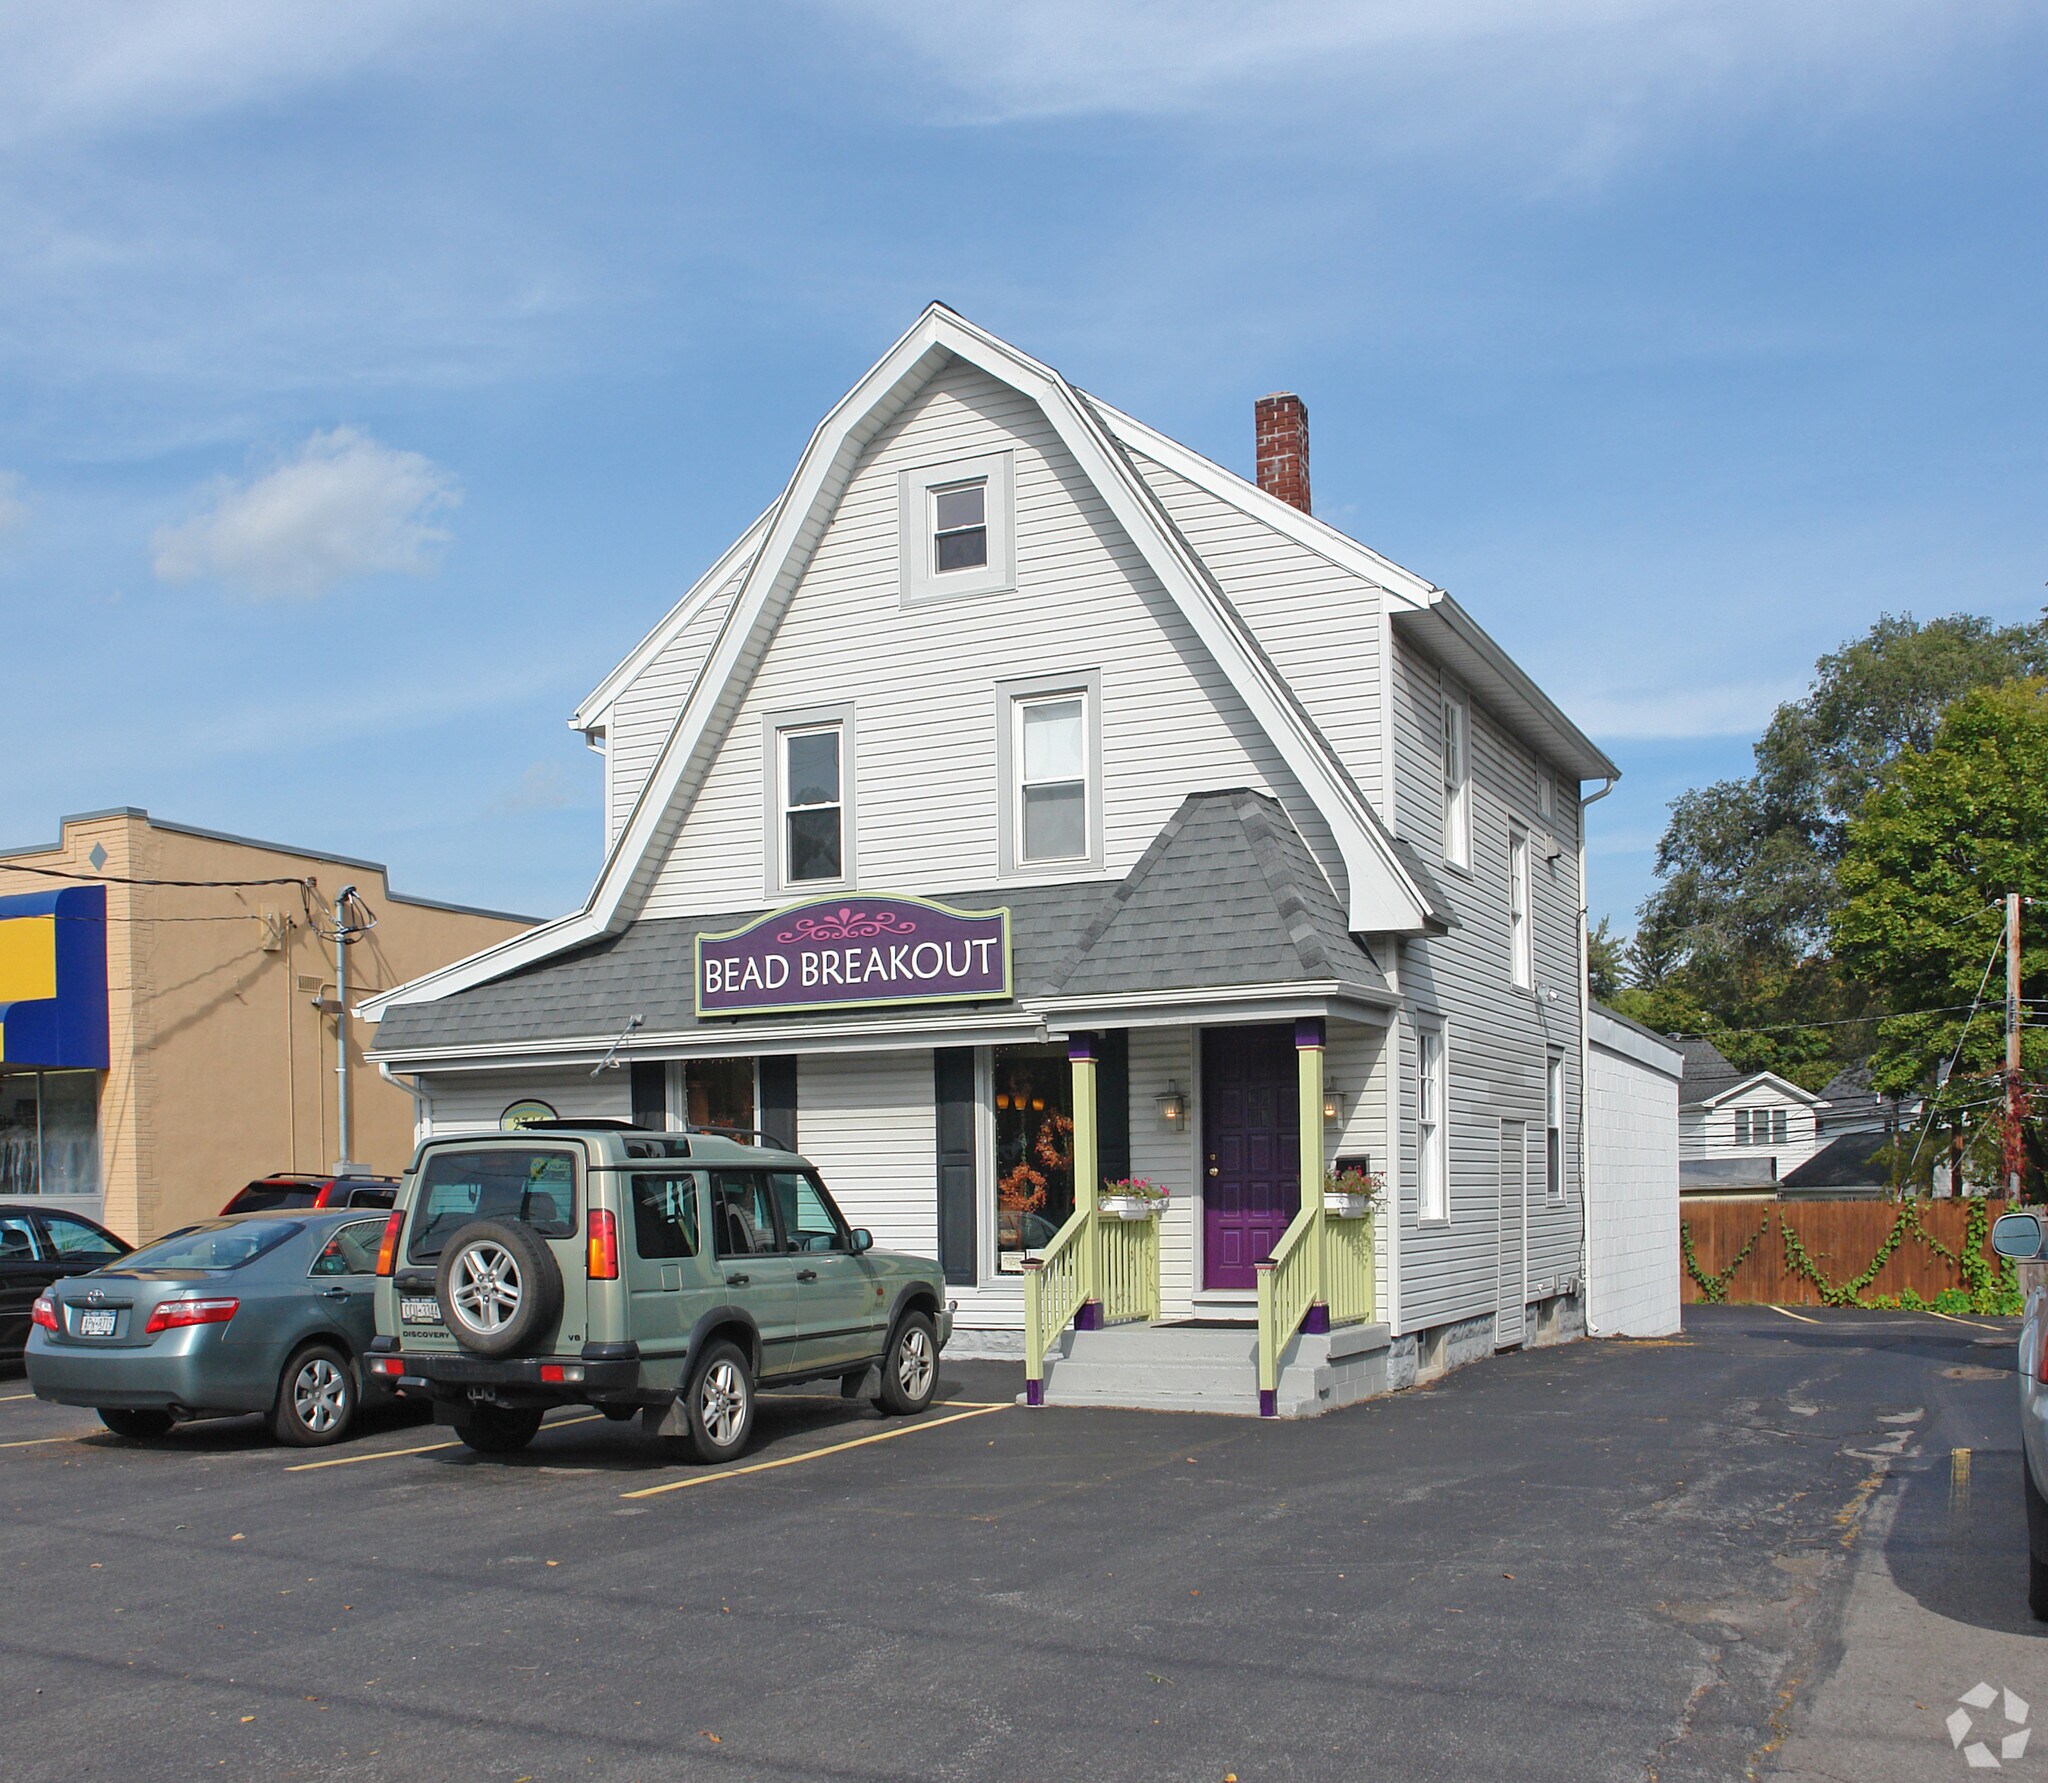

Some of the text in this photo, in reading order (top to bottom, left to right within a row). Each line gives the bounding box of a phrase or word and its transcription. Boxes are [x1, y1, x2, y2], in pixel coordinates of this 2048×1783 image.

[704, 937, 998, 994] BEAD BREAKOUT
[402, 1330, 450, 1339] DISCOVERY
